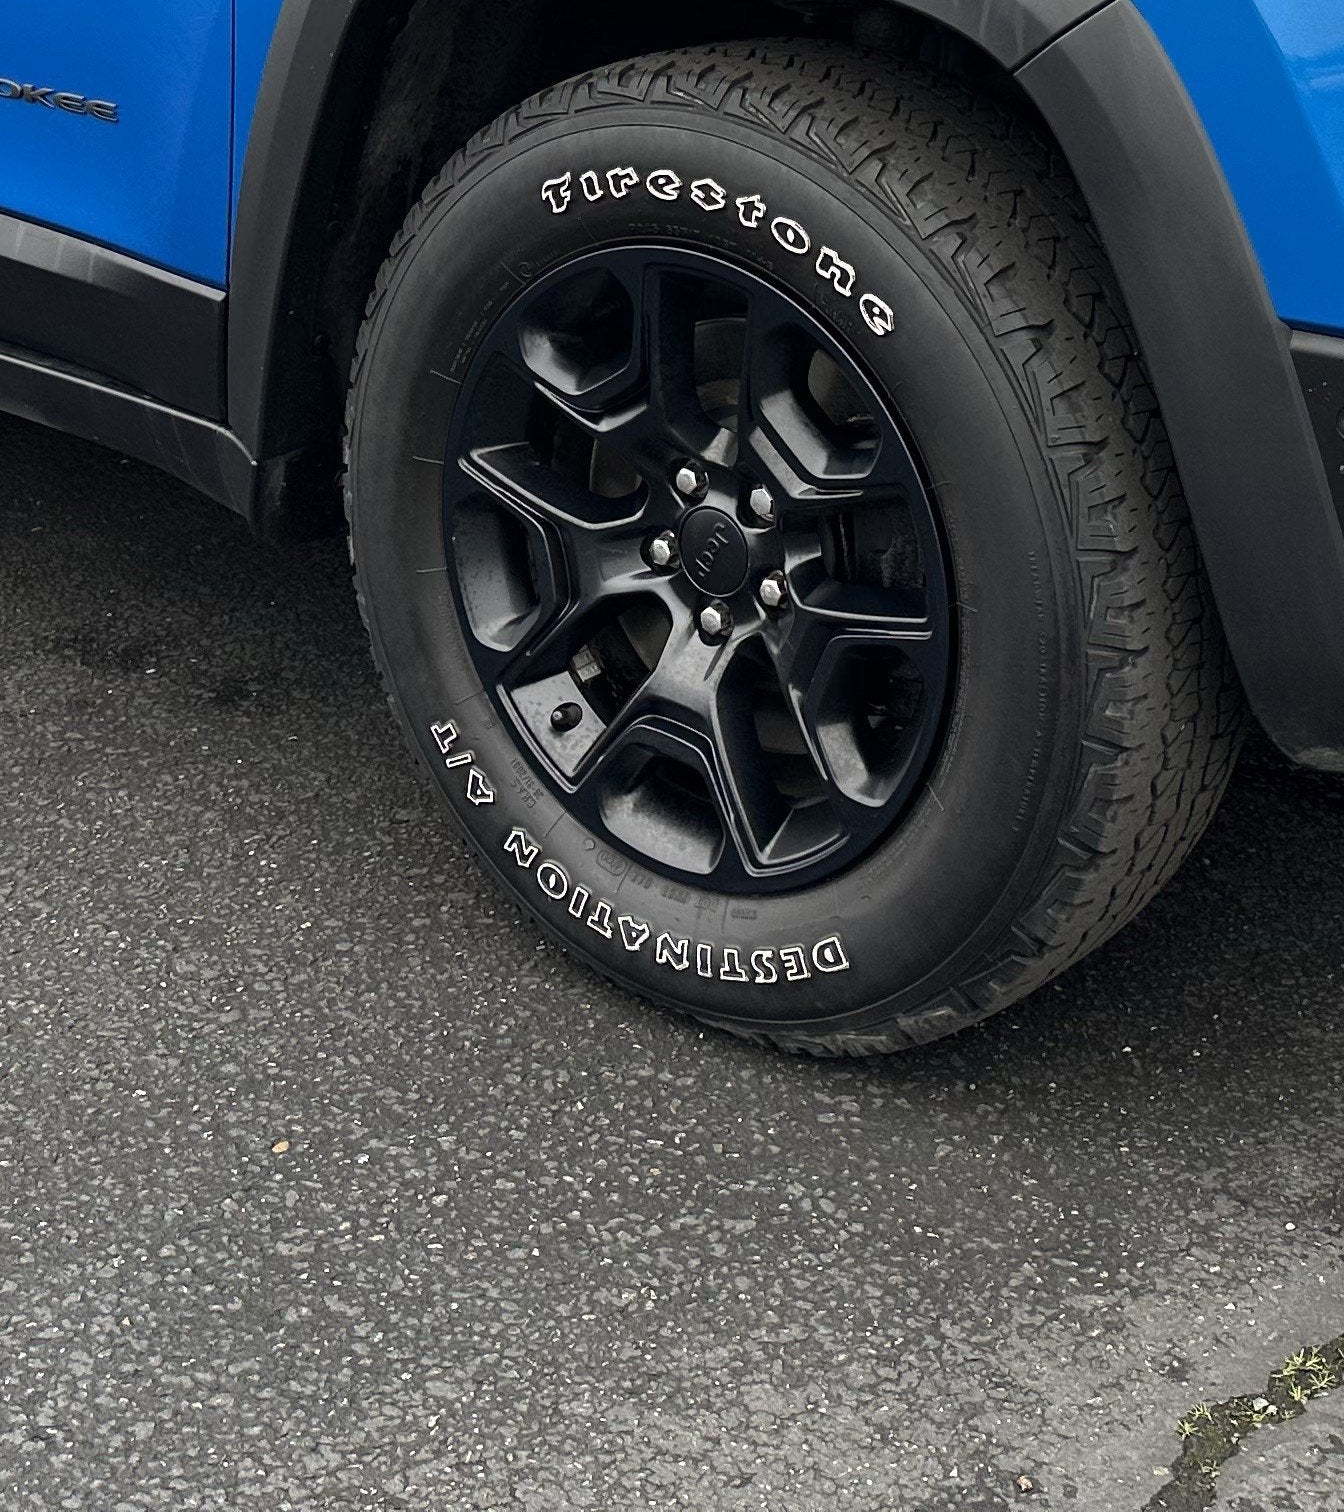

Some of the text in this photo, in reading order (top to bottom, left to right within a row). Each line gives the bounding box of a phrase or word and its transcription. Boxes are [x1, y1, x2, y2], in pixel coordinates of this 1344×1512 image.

[541, 167, 896, 336] Firestone
[694, 521, 730, 578] Jeep
[430, 720, 850, 984] DESTINATION A/T
